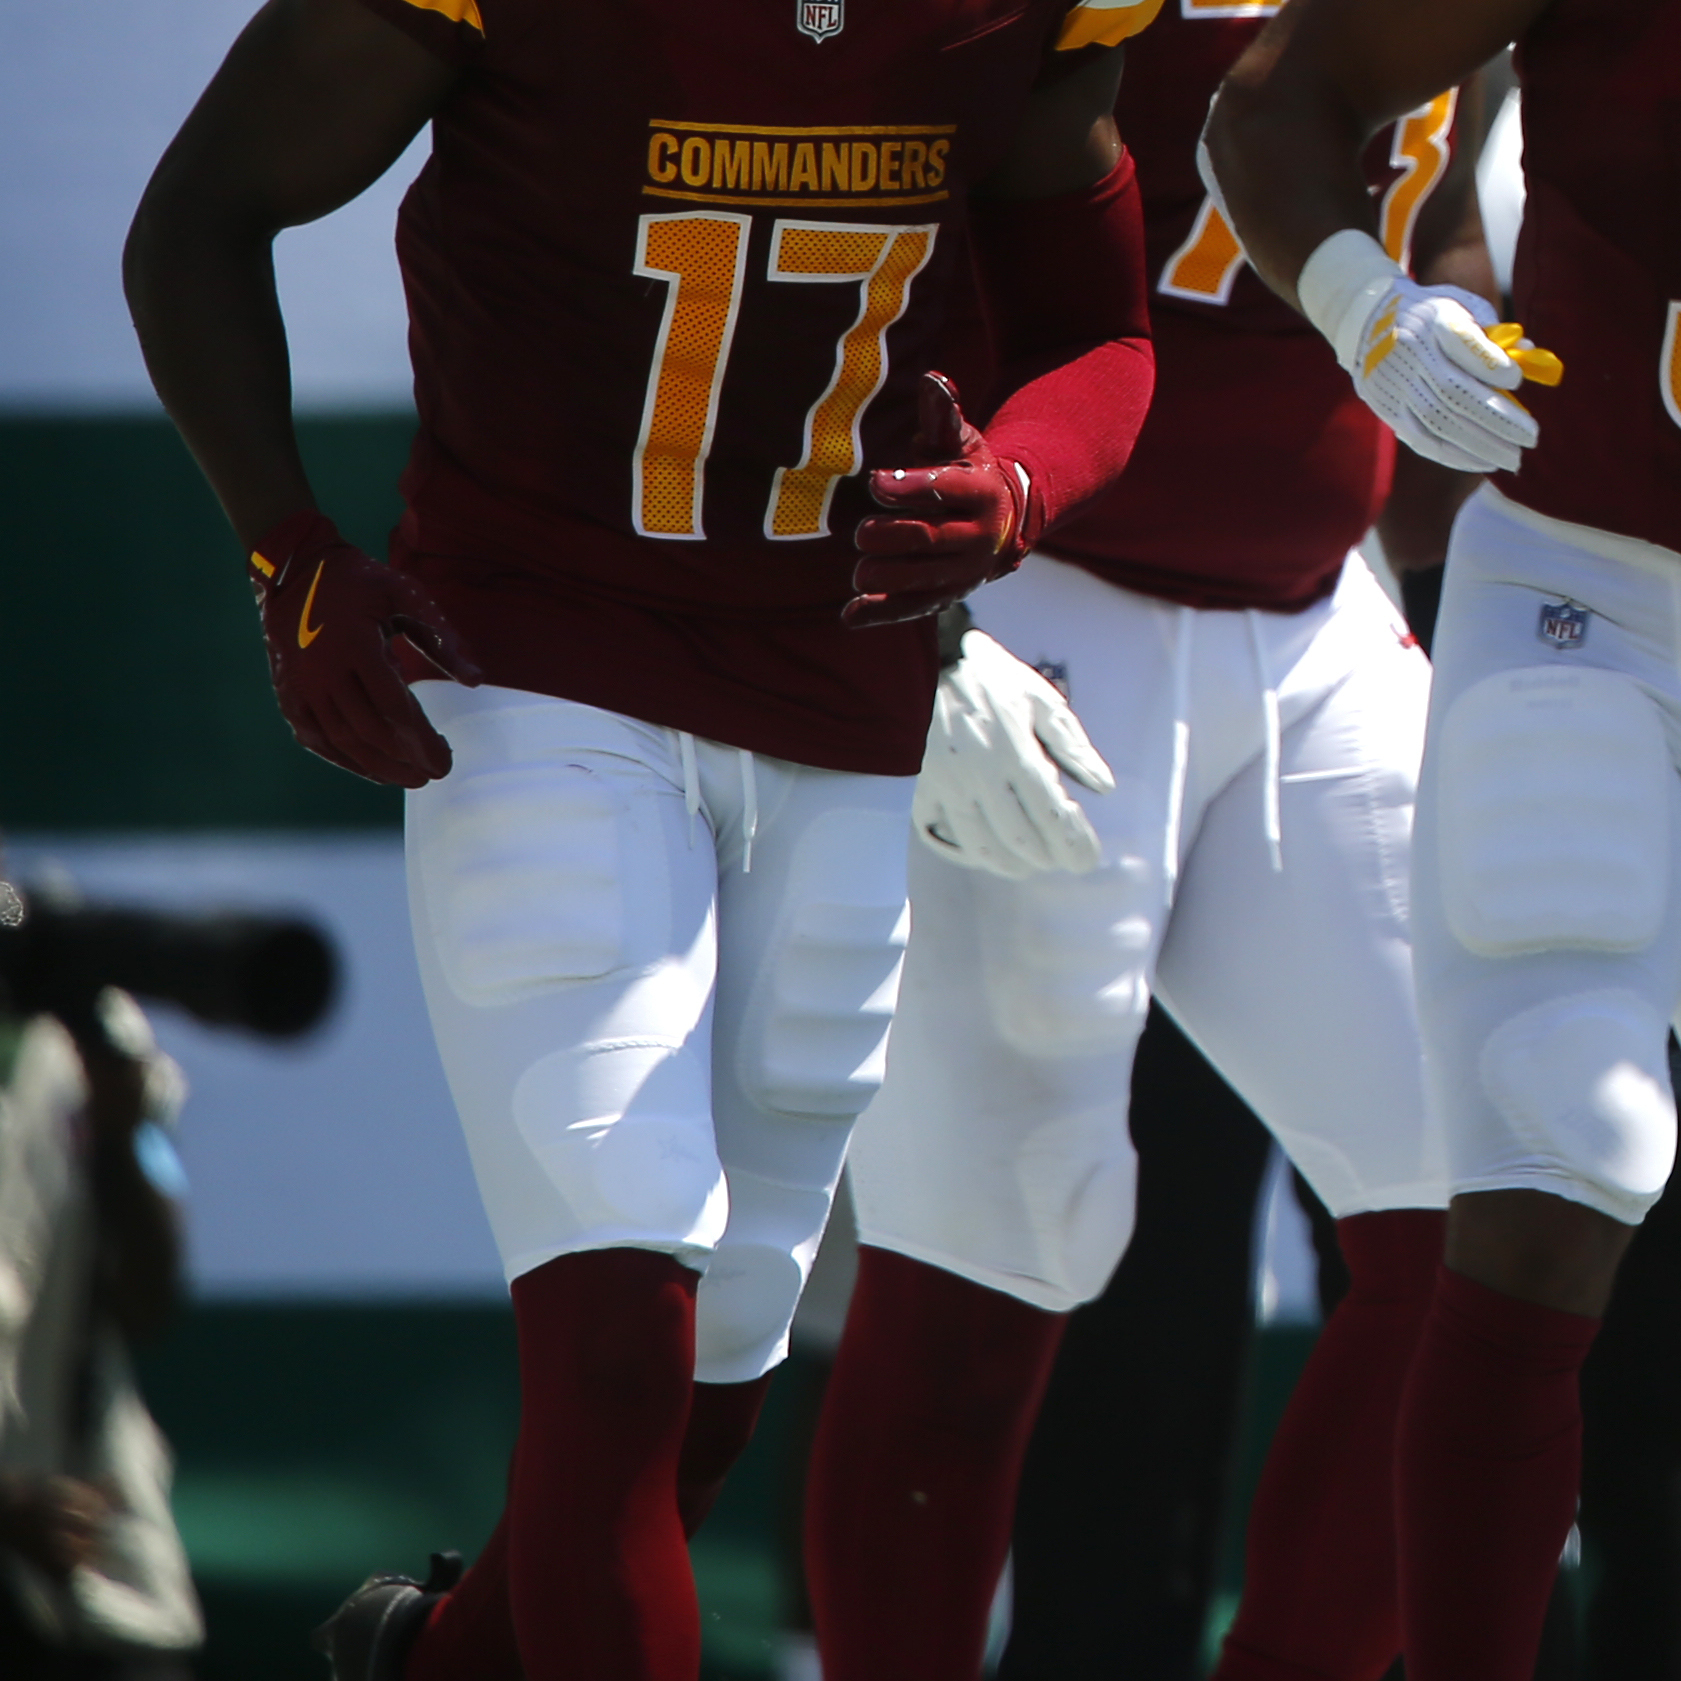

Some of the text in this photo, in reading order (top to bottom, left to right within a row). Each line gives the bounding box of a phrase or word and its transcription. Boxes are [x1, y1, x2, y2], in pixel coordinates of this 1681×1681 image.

[804, 4, 838, 32] NFL
[647, 132, 949, 192] COMMANDERS
[632, 209, 940, 541] 17
[1546, 619, 1580, 639] NFL
